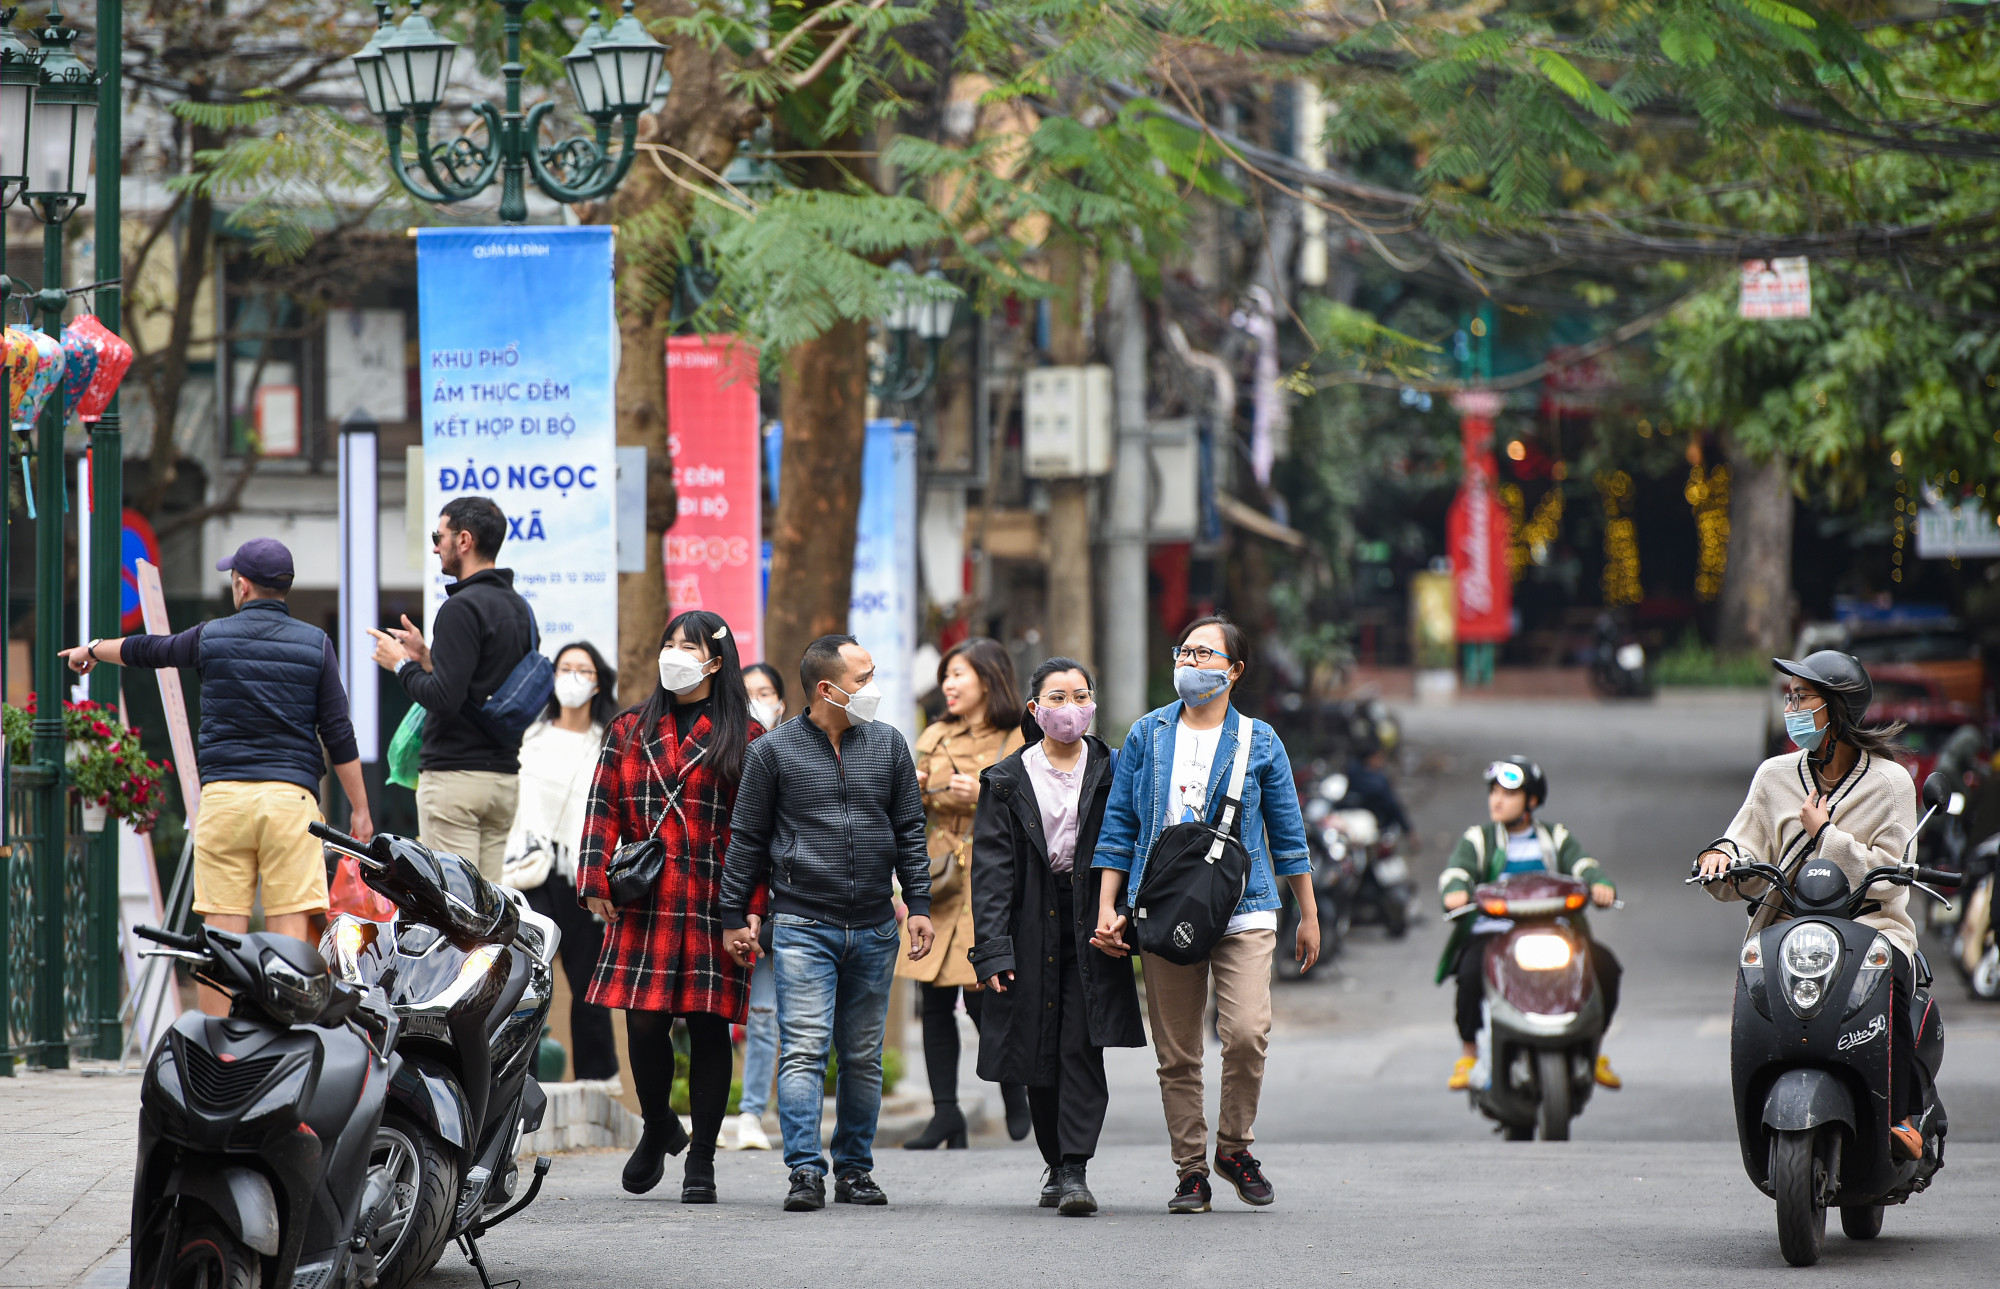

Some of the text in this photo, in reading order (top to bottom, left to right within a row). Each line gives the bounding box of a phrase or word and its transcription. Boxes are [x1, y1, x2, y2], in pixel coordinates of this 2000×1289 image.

[432, 341, 520, 368] KHU PHỐ
[527, 378, 571, 400] ĐÊM
[433, 413, 470, 437] KẾT
[520, 417, 541, 435] ĐI
[547, 412, 576, 439] BỘ
[439, 458, 598, 497] ĐẢO NGỌC
[508, 510, 546, 541] XÃ
[1806, 868, 1831, 878] SYM
